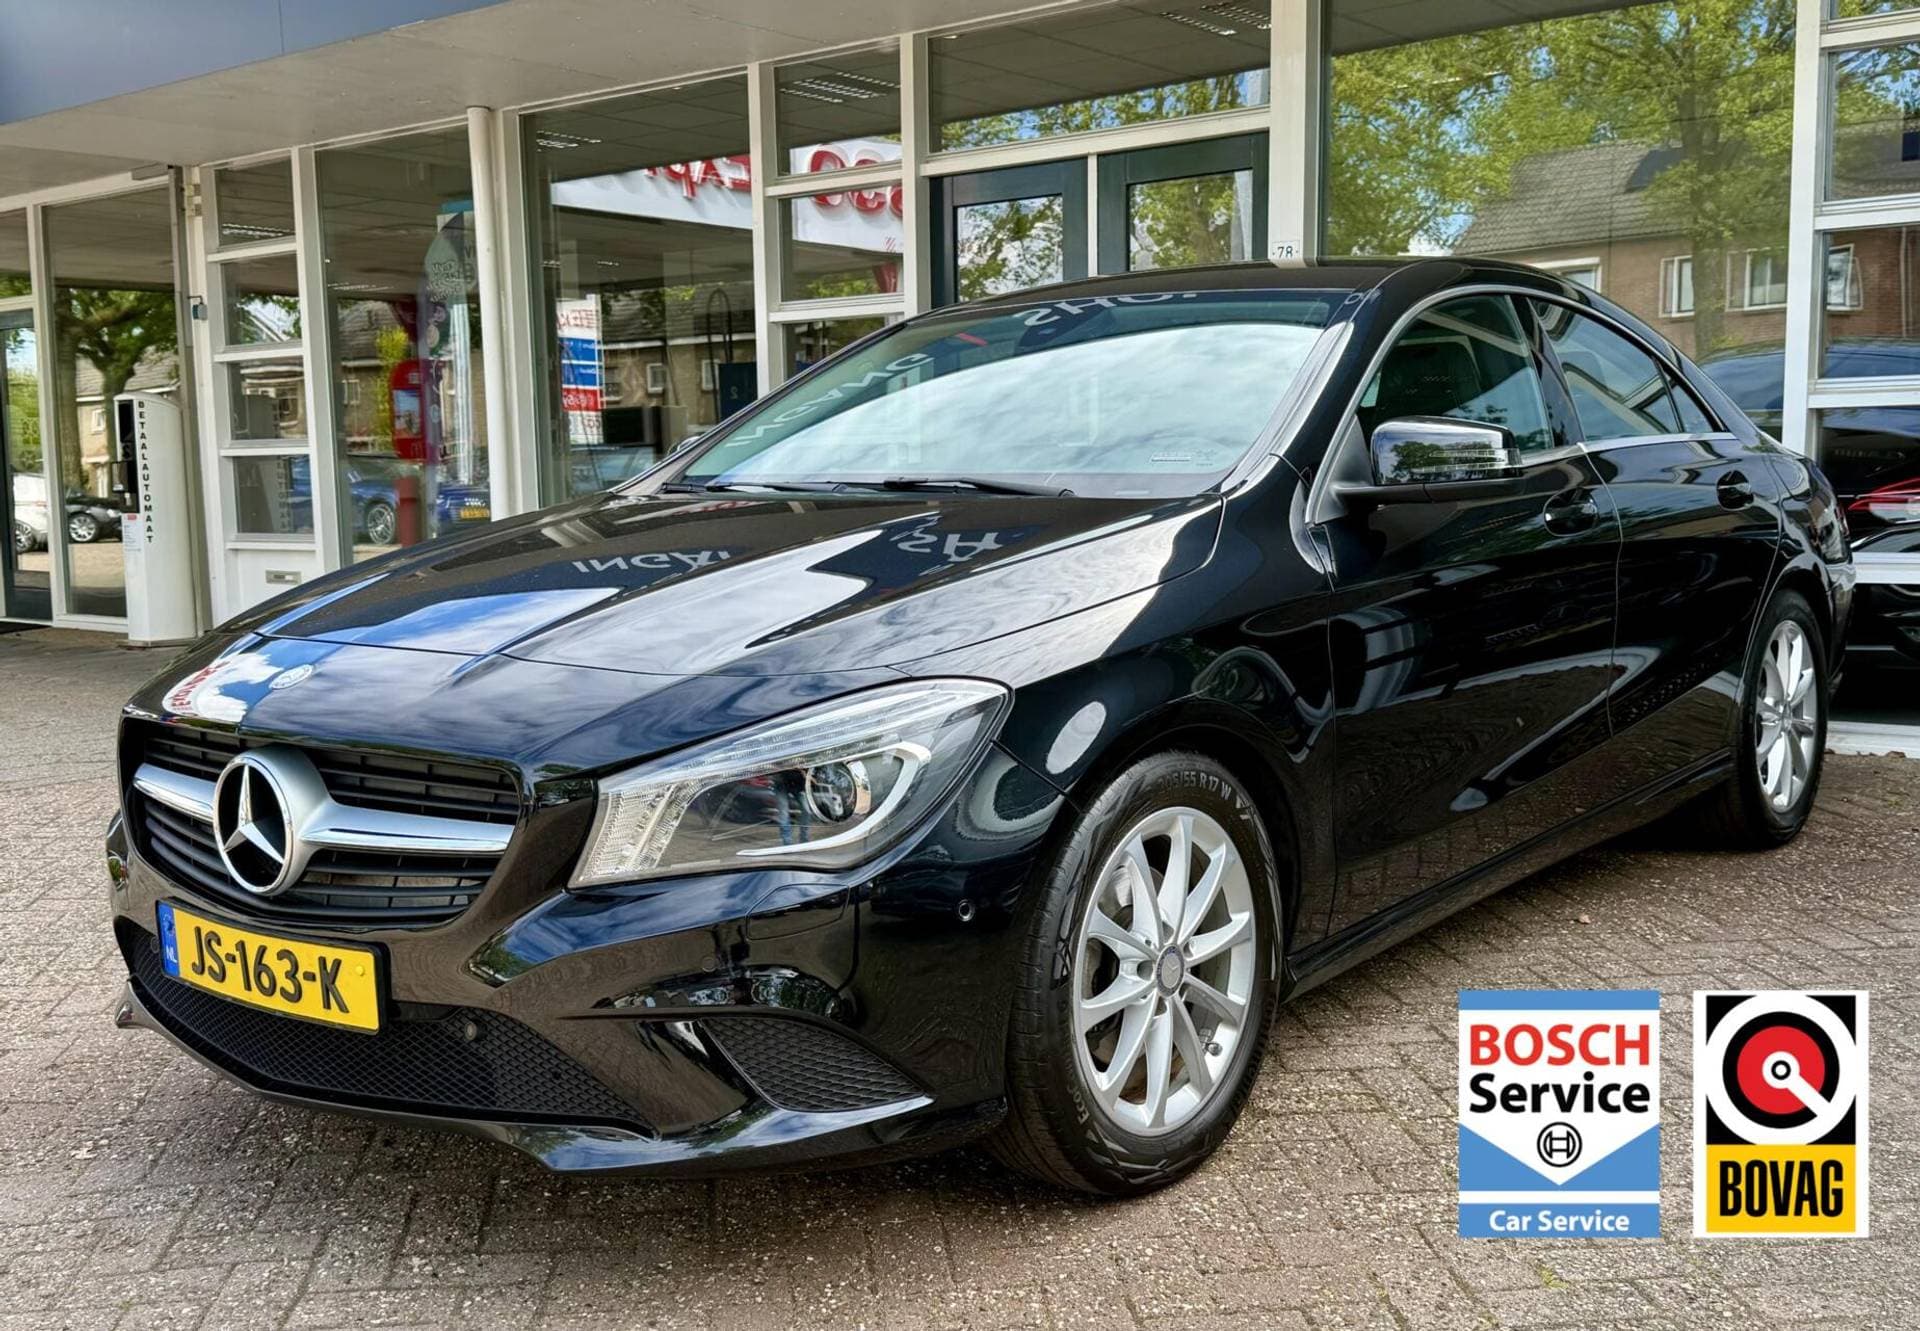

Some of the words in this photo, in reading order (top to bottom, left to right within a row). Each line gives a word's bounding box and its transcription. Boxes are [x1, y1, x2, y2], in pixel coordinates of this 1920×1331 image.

[1277, 245, 1293, 258] 78
[138, 401, 153, 543] BETAALAUTOMAAT
[166, 946, 177, 963] NL
[191, 926, 350, 1013] JS-163-K
